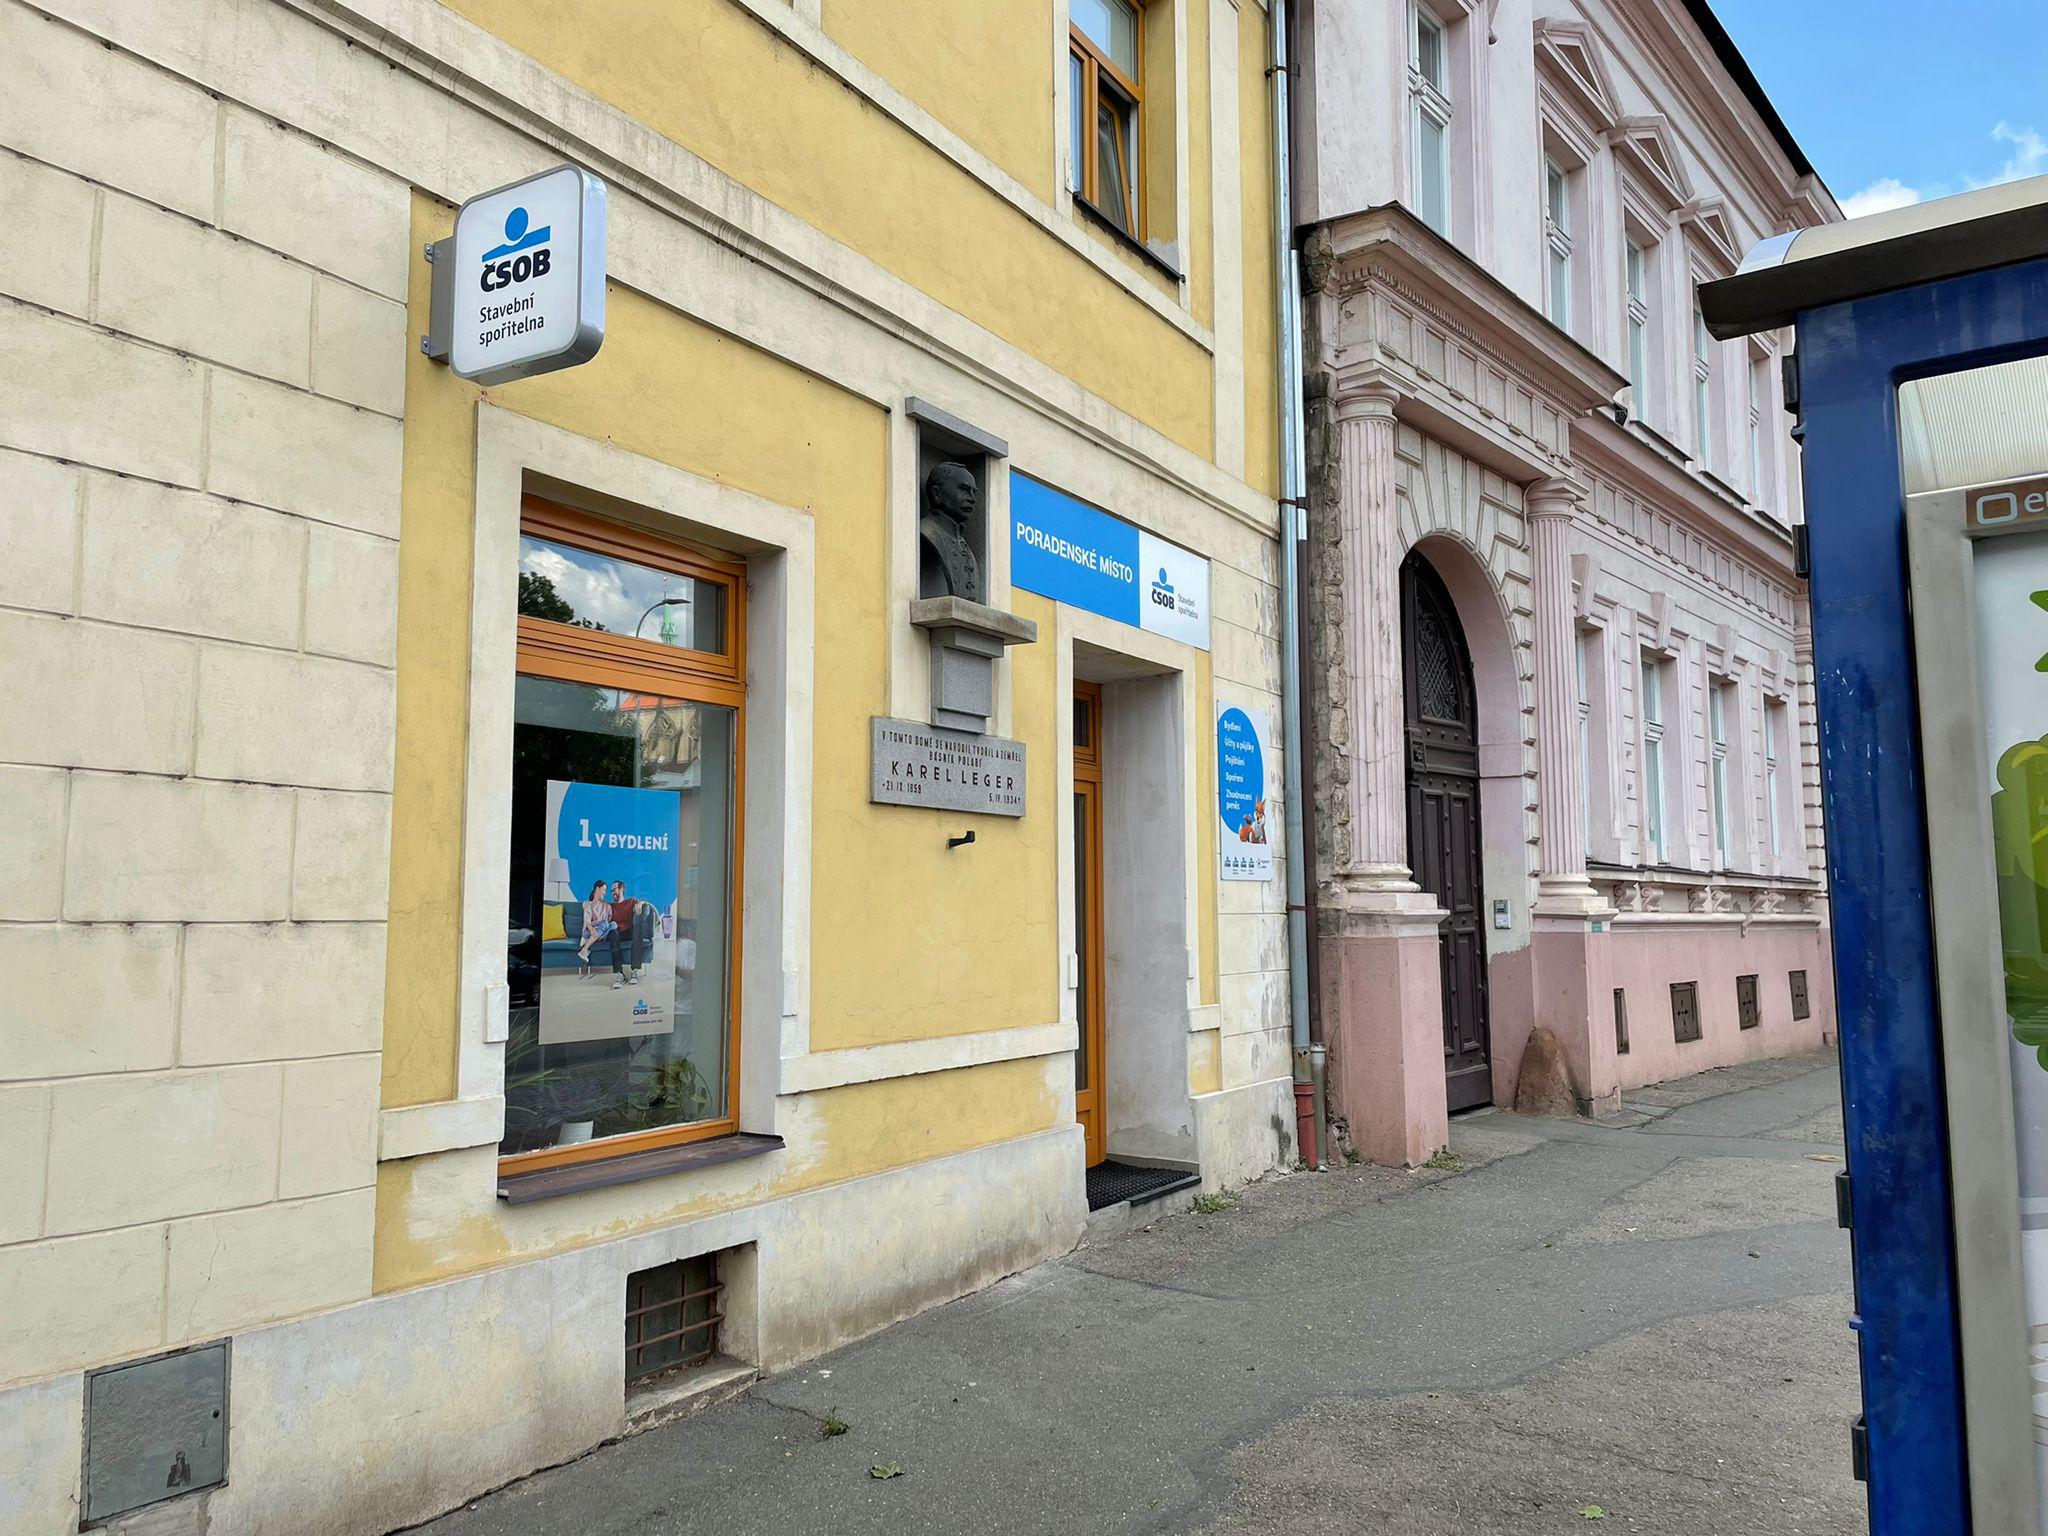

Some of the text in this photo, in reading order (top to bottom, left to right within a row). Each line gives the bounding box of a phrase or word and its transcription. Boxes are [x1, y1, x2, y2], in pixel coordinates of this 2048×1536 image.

[480, 248, 551, 293] ČSOB
[479, 292, 535, 323] Stavební
[479, 315, 545, 347] spořitelna
[2024, 492, 2048, 513] e
[1016, 521, 1133, 584] PORADENSKÉ MÍSTO
[1151, 587, 1175, 610] ČSOB
[889, 731, 913, 745] TOMTO
[891, 760, 1014, 790] KAREL LEGER
[578, 818, 669, 851] 1 V BYDLENÍ
